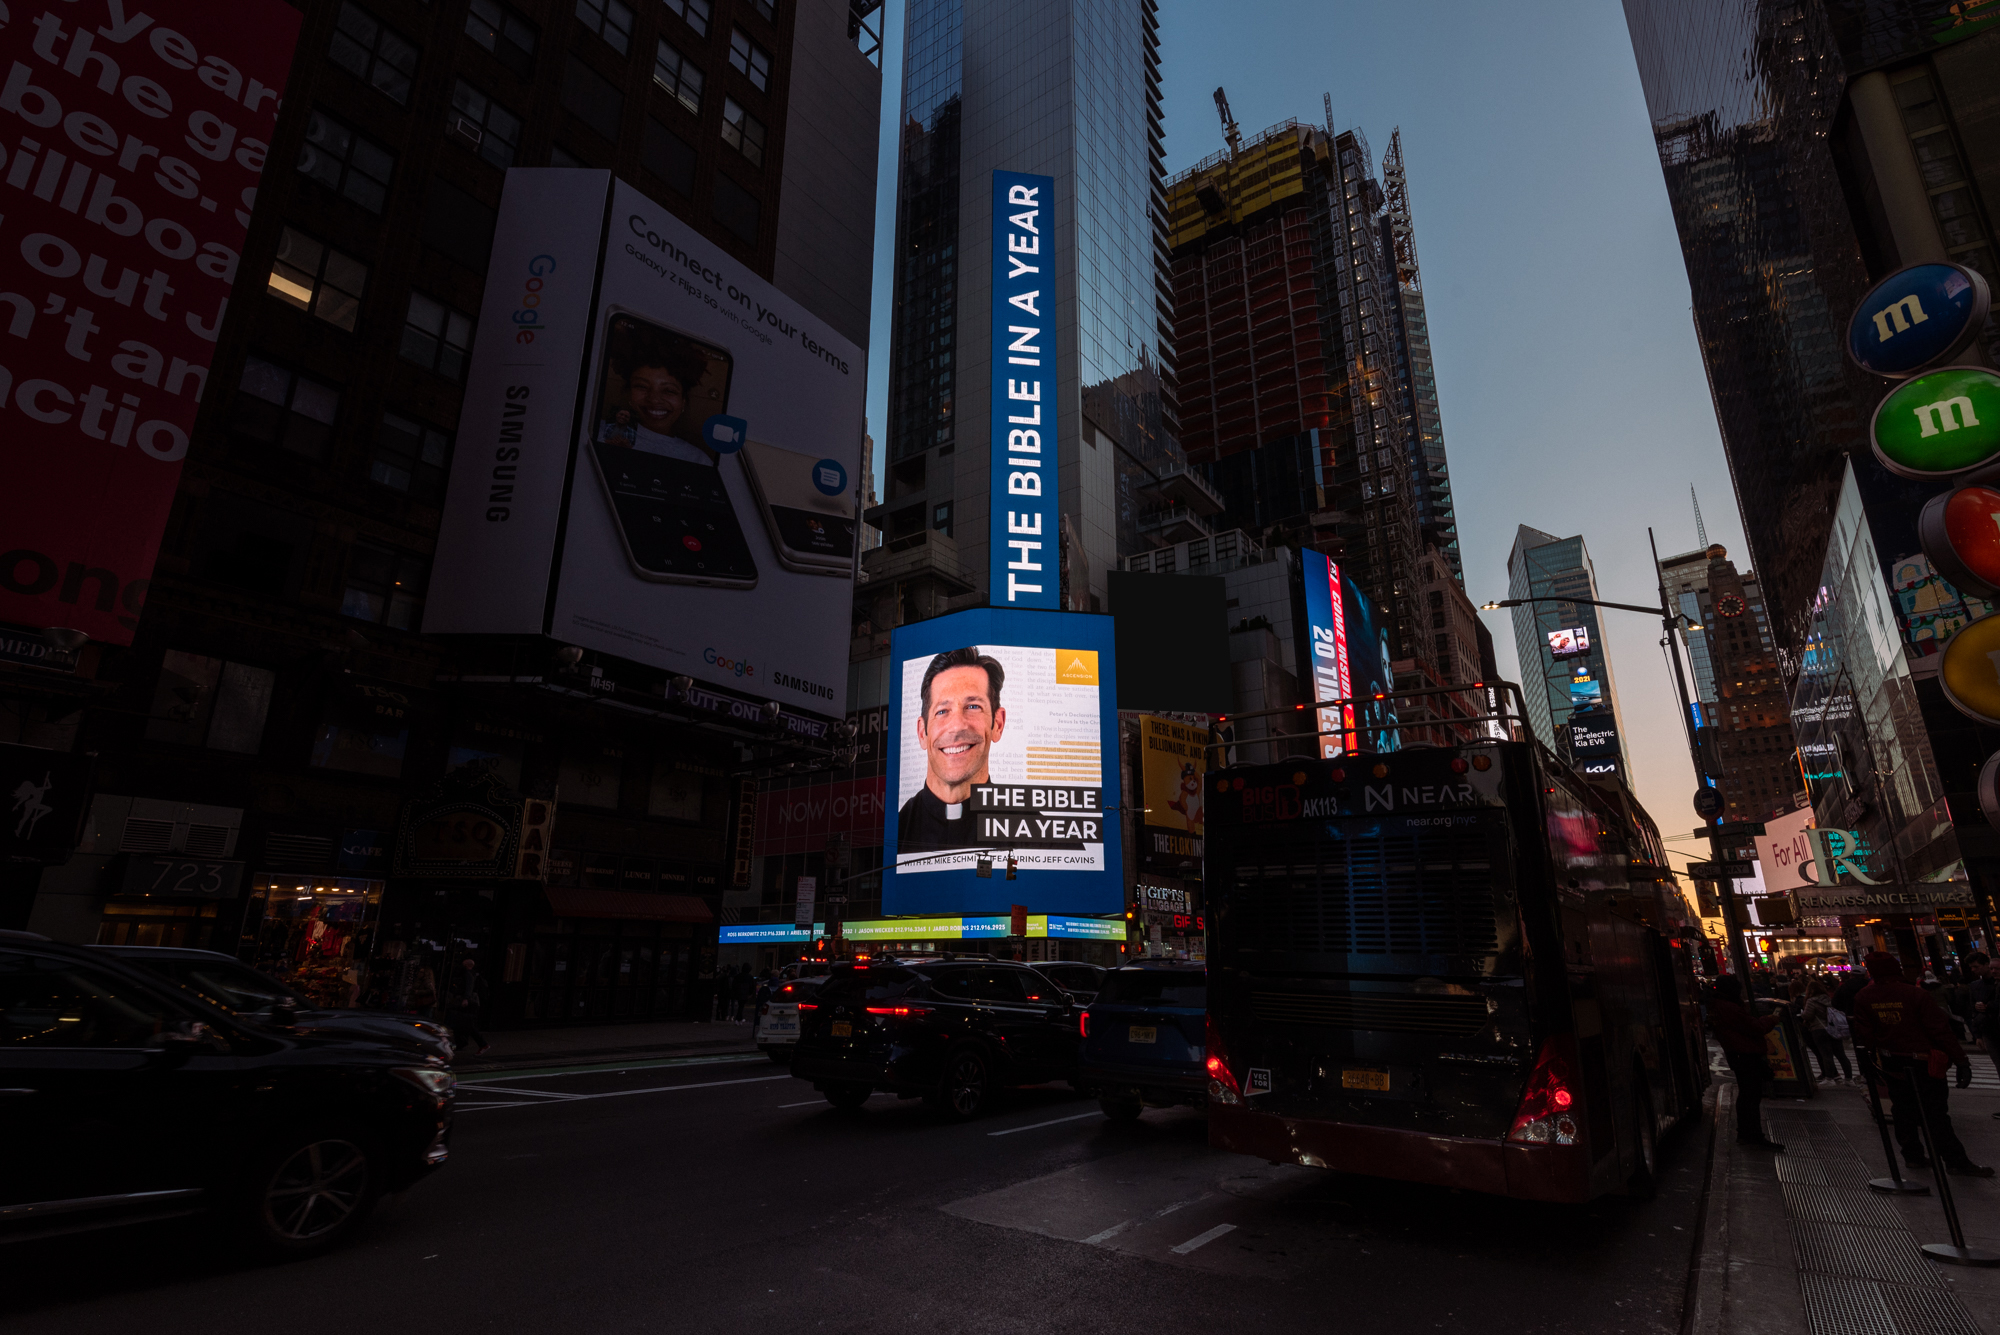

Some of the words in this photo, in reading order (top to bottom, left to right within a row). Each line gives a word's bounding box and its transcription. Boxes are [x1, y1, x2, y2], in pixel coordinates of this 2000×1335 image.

[32, 10, 174, 118] the
[97, 0, 284, 121] year
[1008, 184, 1039, 279] YEAR
[20, 232, 175, 322] out
[512, 253, 556, 345] Google
[625, 242, 668, 278] Galaxy
[669, 271, 678, 283] Z
[678, 277, 703, 299] Flip3
[703, 293, 719, 311] 5G
[719, 305, 740, 324] with
[741, 319, 773, 345] Google
[628, 214, 723, 290] Connect
[727, 281, 752, 312] on
[755, 297, 799, 339] your
[800, 331, 850, 376] terms
[1008, 289, 1040, 317] A
[1872, 294, 1929, 343] m
[1008, 325, 1040, 367] IN
[1913, 396, 1980, 439] m
[486, 384, 530, 522] SAMSUNG
[1008, 379, 1041, 498] BIBLE
[1008, 511, 1042, 602] THE
[1332, 590, 1346, 643] COME
[1313, 625, 1336, 660] 20
[591, 676, 615, 692] M-151
[703, 647, 754, 677] Google
[773, 671, 834, 700] SAMSUNG
[1574, 675, 1591, 684] 2021
[375, 704, 405, 718] BAR
[475, 721, 544, 743] BRASSERIE
[1151, 720, 1170, 737] THERE
[1171, 726, 1185, 741] WAS
[1187, 730, 1191, 742] A
[1574, 730, 1615, 740] all-electric
[1589, 738, 1606, 746] EV6
[1149, 736, 1188, 757] BILLIONAIRE,
[1190, 746, 1202, 760] AND
[778, 798, 827, 825] NOW
[833, 791, 886, 818] OPEN
[977, 788, 1026, 809] THE
[1031, 789, 1097, 810] BIBLE
[1242, 786, 1275, 806] BIG
[1303, 796, 1338, 818] AK113
[1402, 783, 1474, 805] NEAR
[1242, 804, 1275, 823] BUS
[432, 820, 498, 850] TSQ
[984, 818, 1009, 837] IN
[1015, 819, 1032, 838] A
[1035, 819, 1098, 839] YEAR
[1406, 815, 1477, 827] near.org/nyc
[351, 846, 383, 857] CAFE
[521, 803, 547, 876] BAR
[1772, 843, 1791, 868] For
[1793, 835, 1809, 863] All
[922, 858, 933, 866] FR.
[934, 856, 951, 865] MIKE
[1043, 855, 1062, 864] JEFF
[1064, 856, 1095, 864] CAVINS
[1698, 866, 1717, 875] ONE
[1725, 865, 1745, 873] WAY
[1800, 827, 1893, 887] R
[151, 861, 224, 893] 723
[625, 870, 650, 880] LUNCH
[662, 873, 685, 882] DINNER
[697, 876, 716, 885] CAFE
[1147, 886, 1185, 902] GIFTS
[1148, 898, 1185, 913] LUGGAGE
[1800, 892, 1911, 909] RENAISSANCE
[1253, 1072, 1267, 1080] VEC
